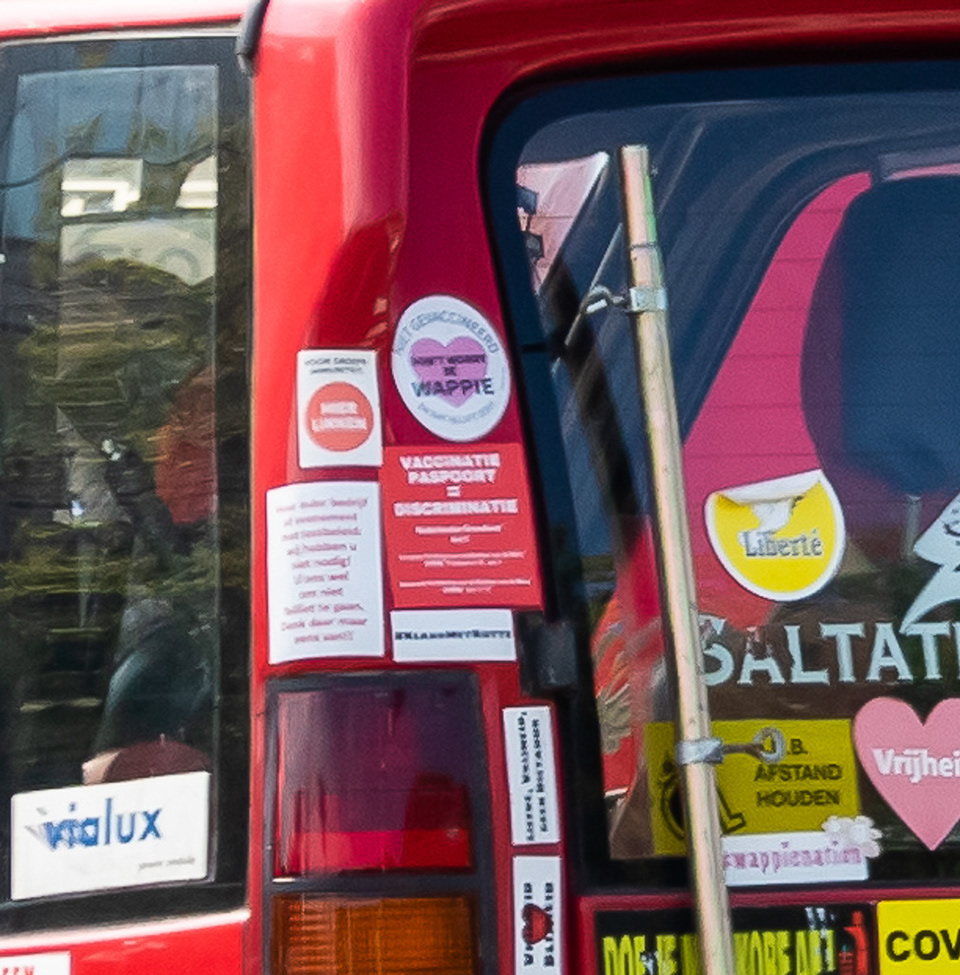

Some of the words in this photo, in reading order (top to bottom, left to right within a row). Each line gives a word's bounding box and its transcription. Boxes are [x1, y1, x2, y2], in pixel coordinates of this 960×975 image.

[411, 378, 494, 397] WAPPIE
[399, 453, 500, 469] VACCINATIE
[407, 469, 496, 484] PASPOORT
[393, 499, 519, 516] DISCRIMINATIE
[743, 528, 823, 556] Liberté
[754, 763, 843, 782] AFSTAND
[755, 788, 841, 807] HOUDEN
[40, 797, 163, 851] vialux
